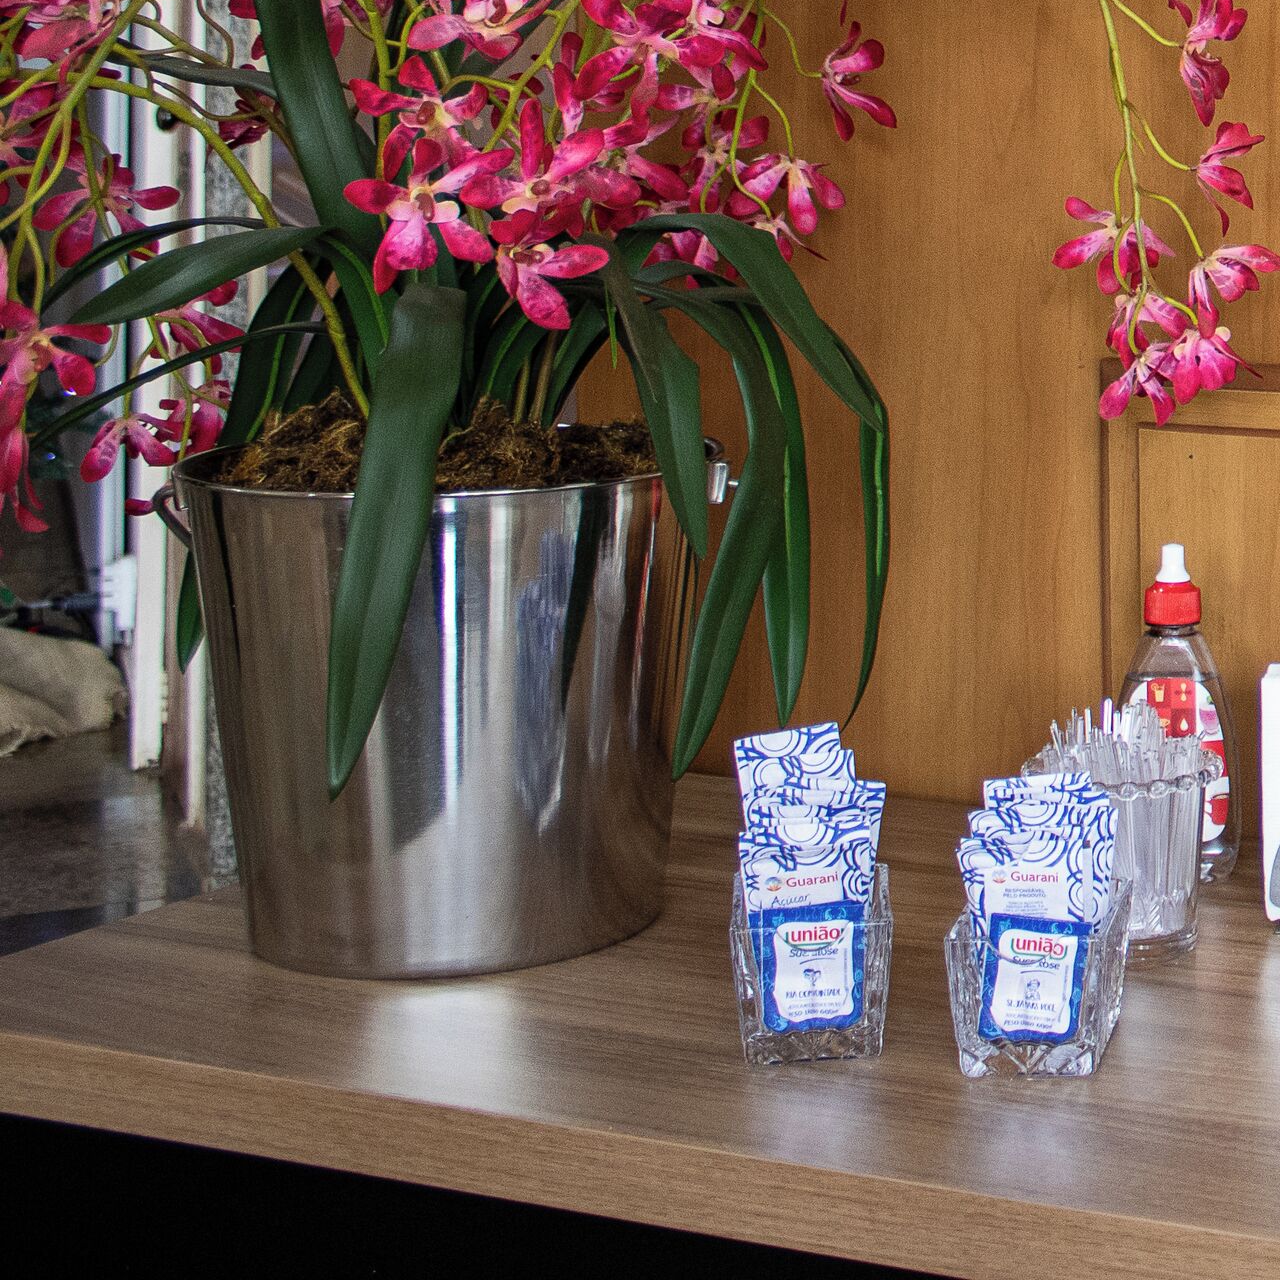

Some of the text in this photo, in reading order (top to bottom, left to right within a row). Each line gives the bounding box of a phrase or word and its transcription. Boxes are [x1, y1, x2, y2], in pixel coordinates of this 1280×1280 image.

[786, 872, 839, 888] Guarani
[1010, 871, 1059, 883] Guarani
[791, 926, 841, 942] união
[1016, 937, 1064, 956] união
